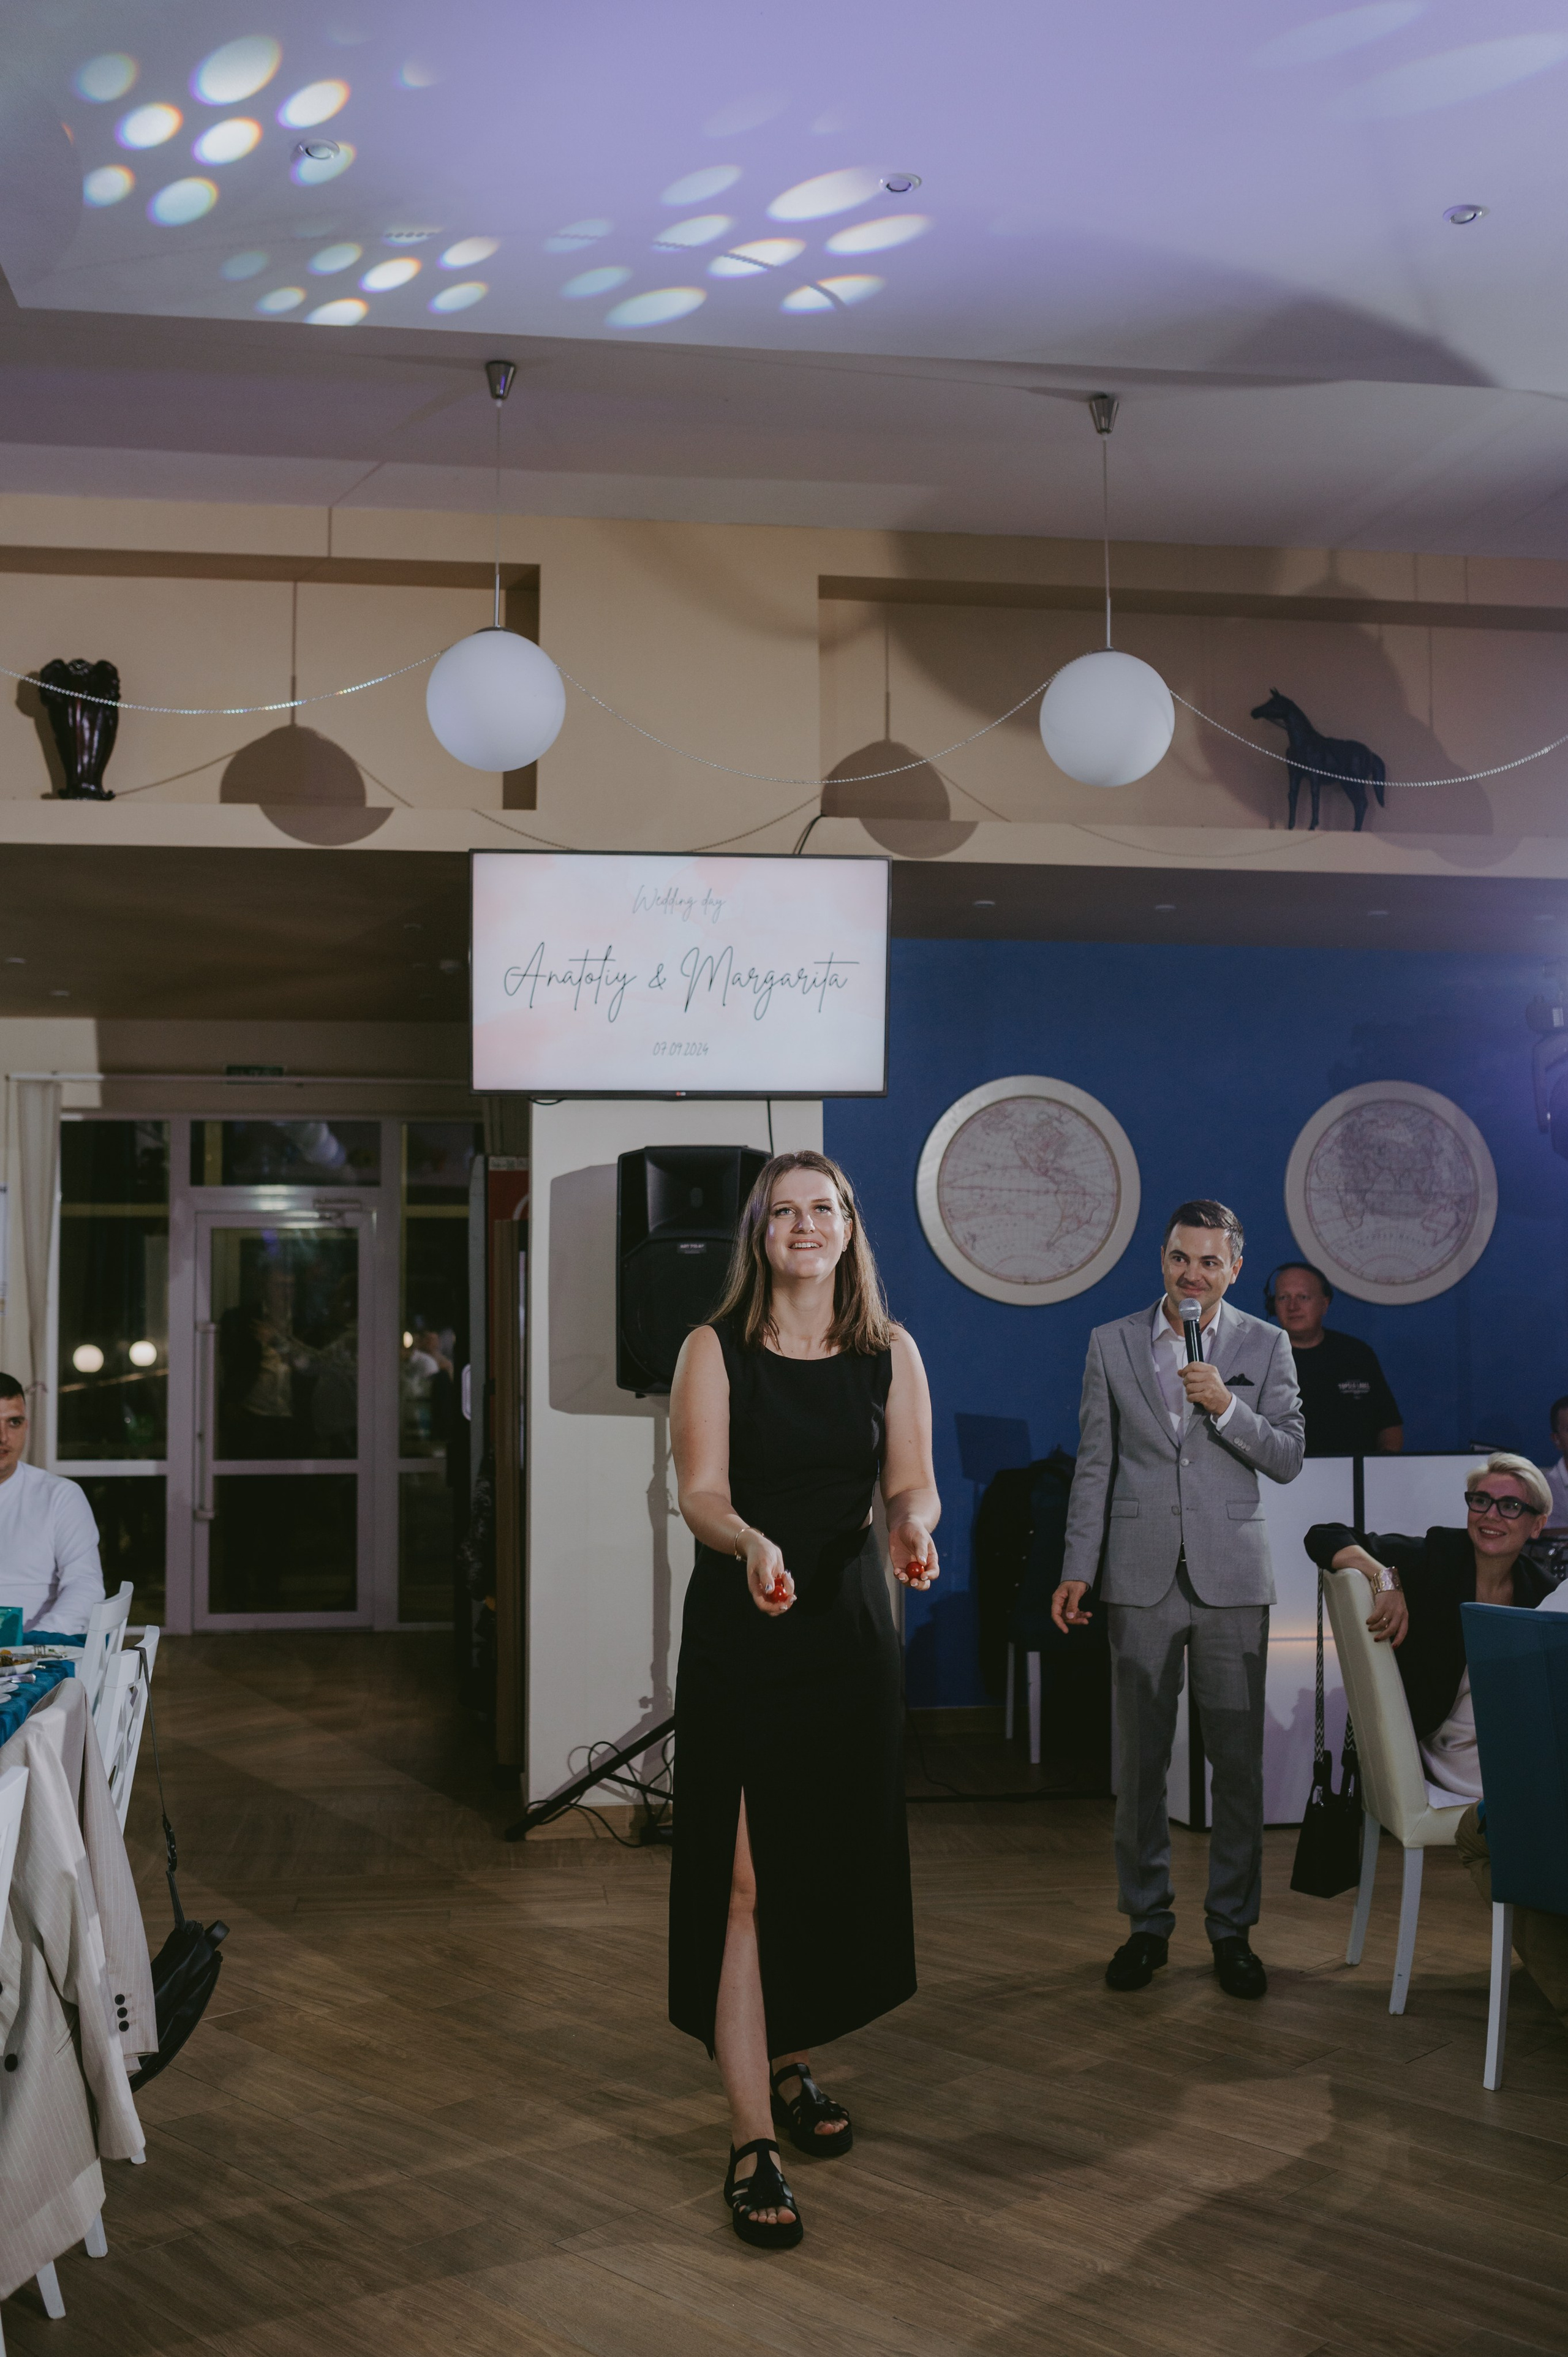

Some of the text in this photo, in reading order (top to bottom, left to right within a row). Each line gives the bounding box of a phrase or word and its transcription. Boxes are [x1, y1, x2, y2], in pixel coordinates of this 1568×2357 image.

[632, 884, 727, 924] Wedding day
[648, 964, 666, 990] &
[680, 946, 859, 1021] Margarita
[652, 1041, 709, 1056] 07.09.2024
